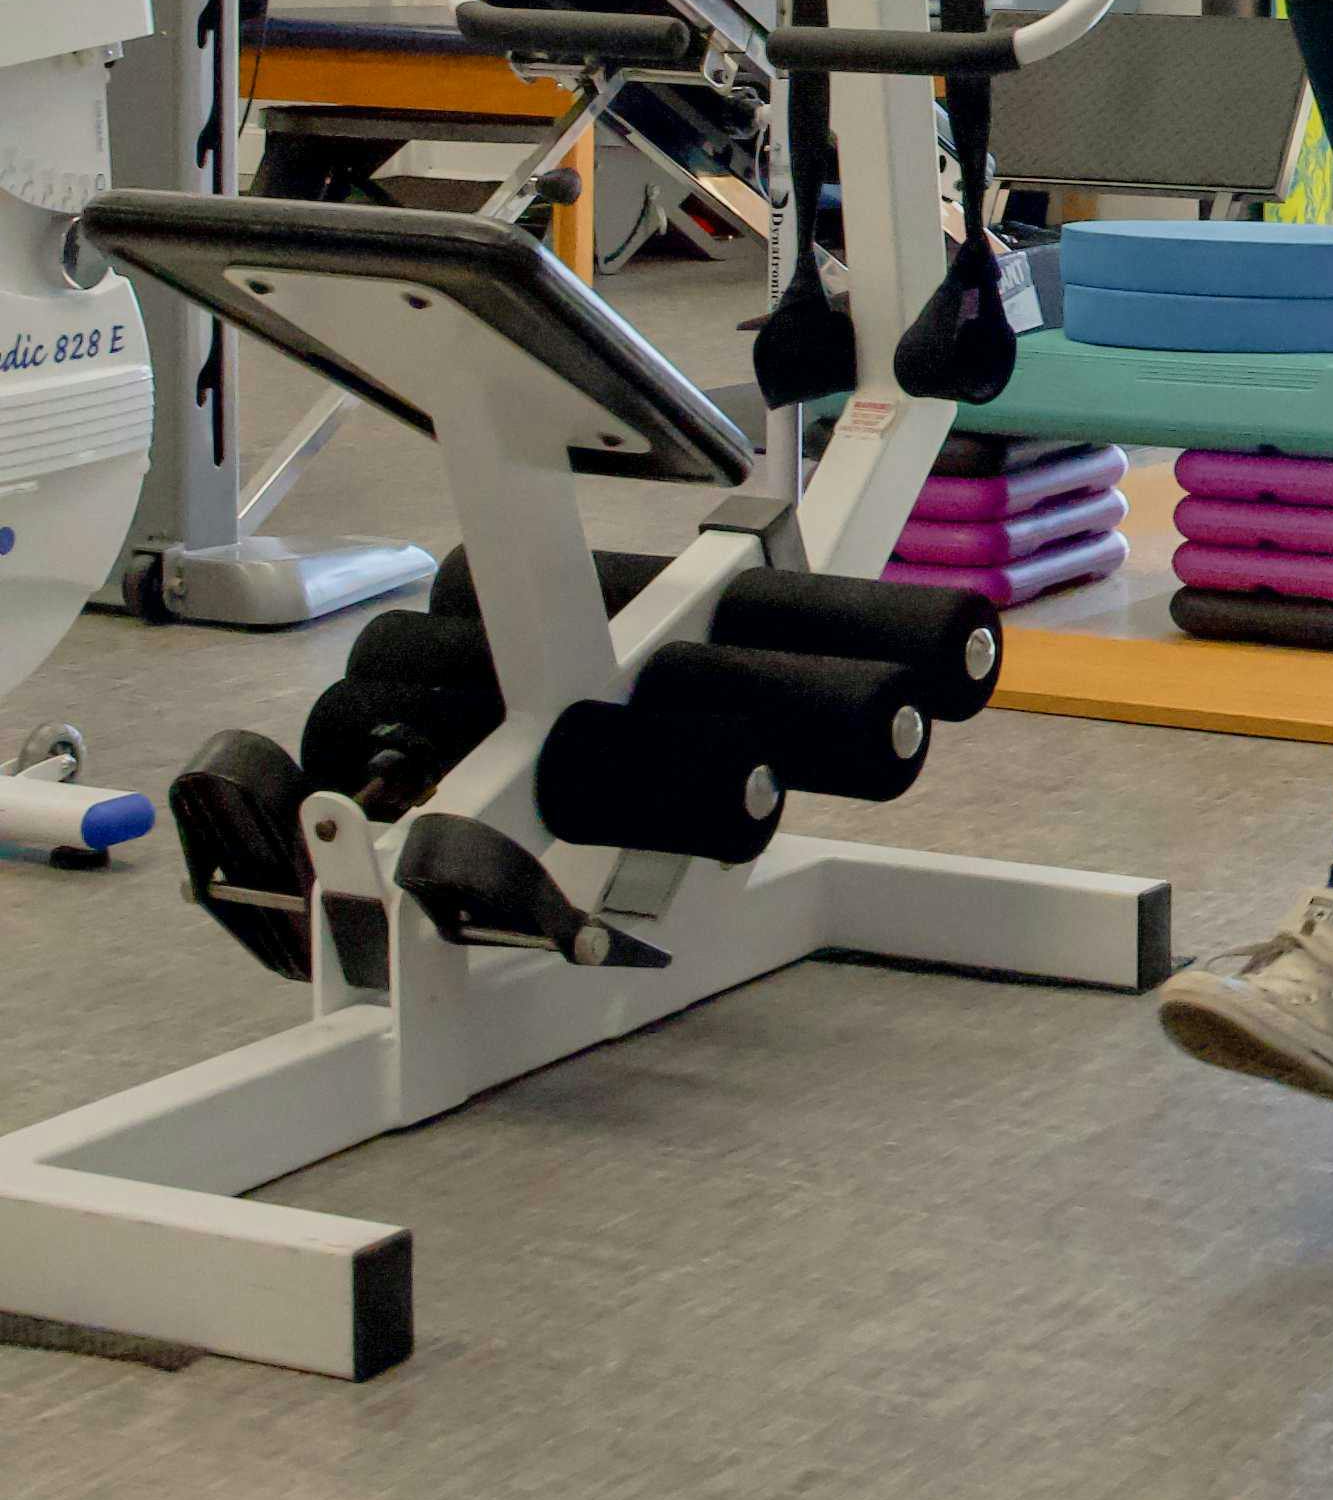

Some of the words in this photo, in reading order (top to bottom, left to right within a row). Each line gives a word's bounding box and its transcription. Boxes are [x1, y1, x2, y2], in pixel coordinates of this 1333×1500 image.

[0, 333, 48, 372] dic
[54, 328, 101, 363] 828
[109, 324, 126, 354] E
